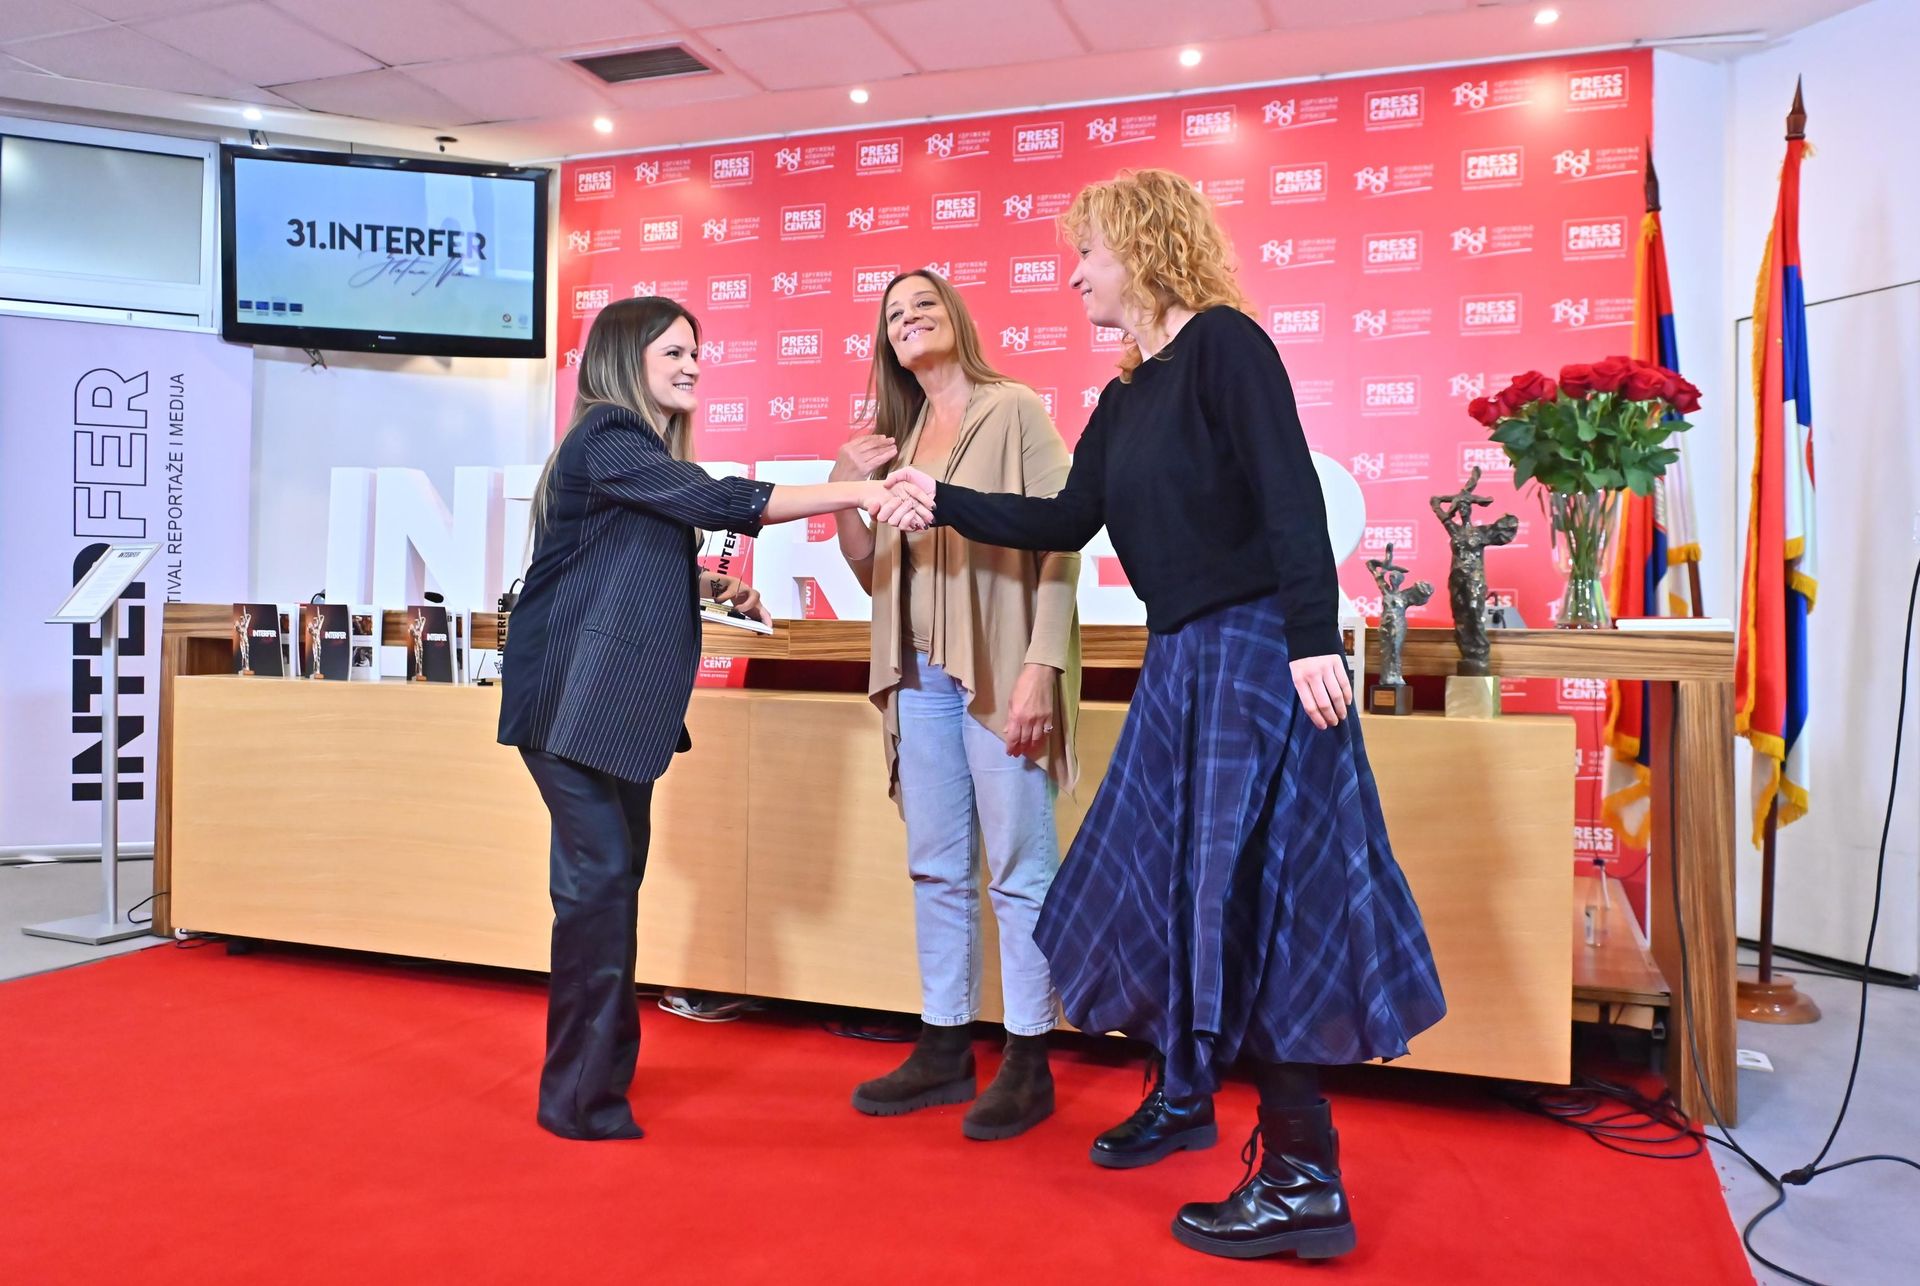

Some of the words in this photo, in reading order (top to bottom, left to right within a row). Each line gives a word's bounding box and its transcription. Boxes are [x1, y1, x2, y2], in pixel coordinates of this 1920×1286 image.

[1570, 73, 1622, 91] PRESS
[1570, 86, 1622, 101] CENTAR
[1371, 94, 1418, 110] PRESS
[1187, 111, 1230, 127] PRESS
[1370, 106, 1418, 120] CENTAR
[1018, 128, 1058, 143] PRESS
[1186, 123, 1230, 136] CENTAR
[861, 143, 898, 157] PRESS
[1018, 139, 1058, 152] CENTAR
[714, 156, 749, 170] PRESS
[860, 154, 898, 166] CENTAR
[1467, 153, 1517, 169] PRESS
[579, 170, 611, 184] PRESS
[714, 167, 749, 179] CENTAR
[1276, 168, 1321, 184] PRESS
[1467, 166, 1517, 179] CENTAR
[578, 181, 611, 192] CENTAR
[1275, 181, 1321, 194] CENTAR
[936, 196, 975, 210] PRESS
[785, 209, 821, 223] PRESS
[936, 208, 975, 220] CENTAR
[644, 220, 678, 233] PRESS
[784, 220, 821, 231] CENTAR
[1569, 223, 1621, 239] PRESS
[286, 218, 487, 260] 31.INTERFER
[644, 231, 677, 242] CENTAR
[1569, 236, 1621, 249] CENTAR
[1368, 237, 1416, 252] PRESS
[1368, 250, 1416, 262] CENTAR
[1015, 260, 1055, 274] PRESS
[857, 270, 895, 283] PRESS
[1014, 272, 1055, 283] CENTAR
[711, 279, 746, 292] PRESS
[857, 282, 887, 292] CENTA
[576, 289, 608, 301] PRESS
[711, 290, 746, 300] CENTAR
[1466, 300, 1515, 314] PRESS
[1273, 309, 1319, 323] PRESS
[1466, 313, 1515, 325] CENTAR
[1273, 322, 1319, 333] CENTAR
[782, 334, 818, 347] PRESS
[781, 345, 817, 355] CENTAR
[1367, 381, 1414, 395] PRESS
[169, 373, 185, 436] MEDIJA
[1366, 394, 1414, 405] CENTAR
[709, 402, 744, 414] PRESS
[708, 413, 744, 423] CENTAR
[1463, 447, 1504, 461] PRES
[166, 452, 184, 553] REPORTAŽE
[1365, 527, 1412, 540] PRESS
[704, 659, 732, 669] CENTA
[1563, 687, 1607, 700] CENTA
[1574, 826, 1614, 840] RESS
